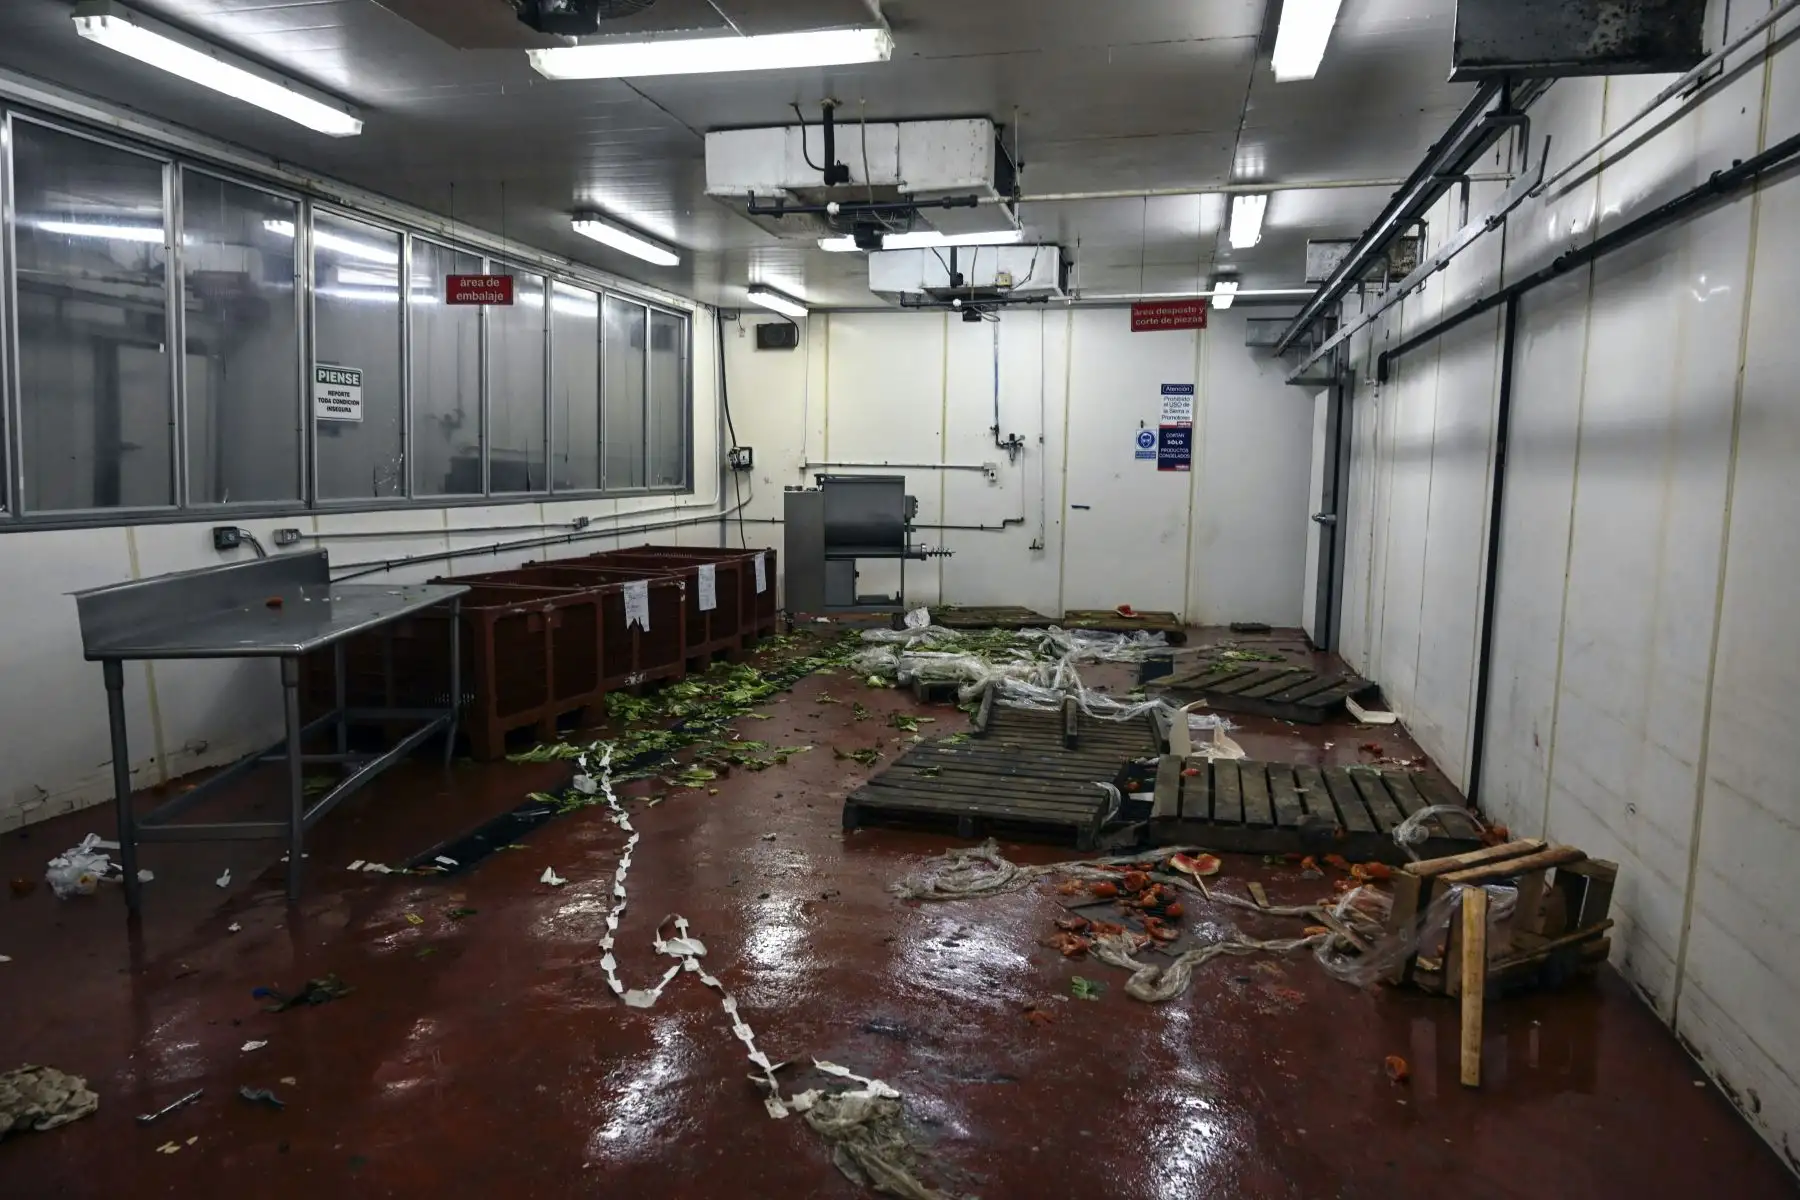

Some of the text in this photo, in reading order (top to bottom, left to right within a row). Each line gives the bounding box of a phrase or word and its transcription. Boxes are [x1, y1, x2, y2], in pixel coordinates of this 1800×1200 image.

[486, 277, 500, 286] de
[456, 291, 503, 302] embalaje
[1135, 316, 1203, 325] corte de piezas
[318, 370, 359, 385] PIENSE
